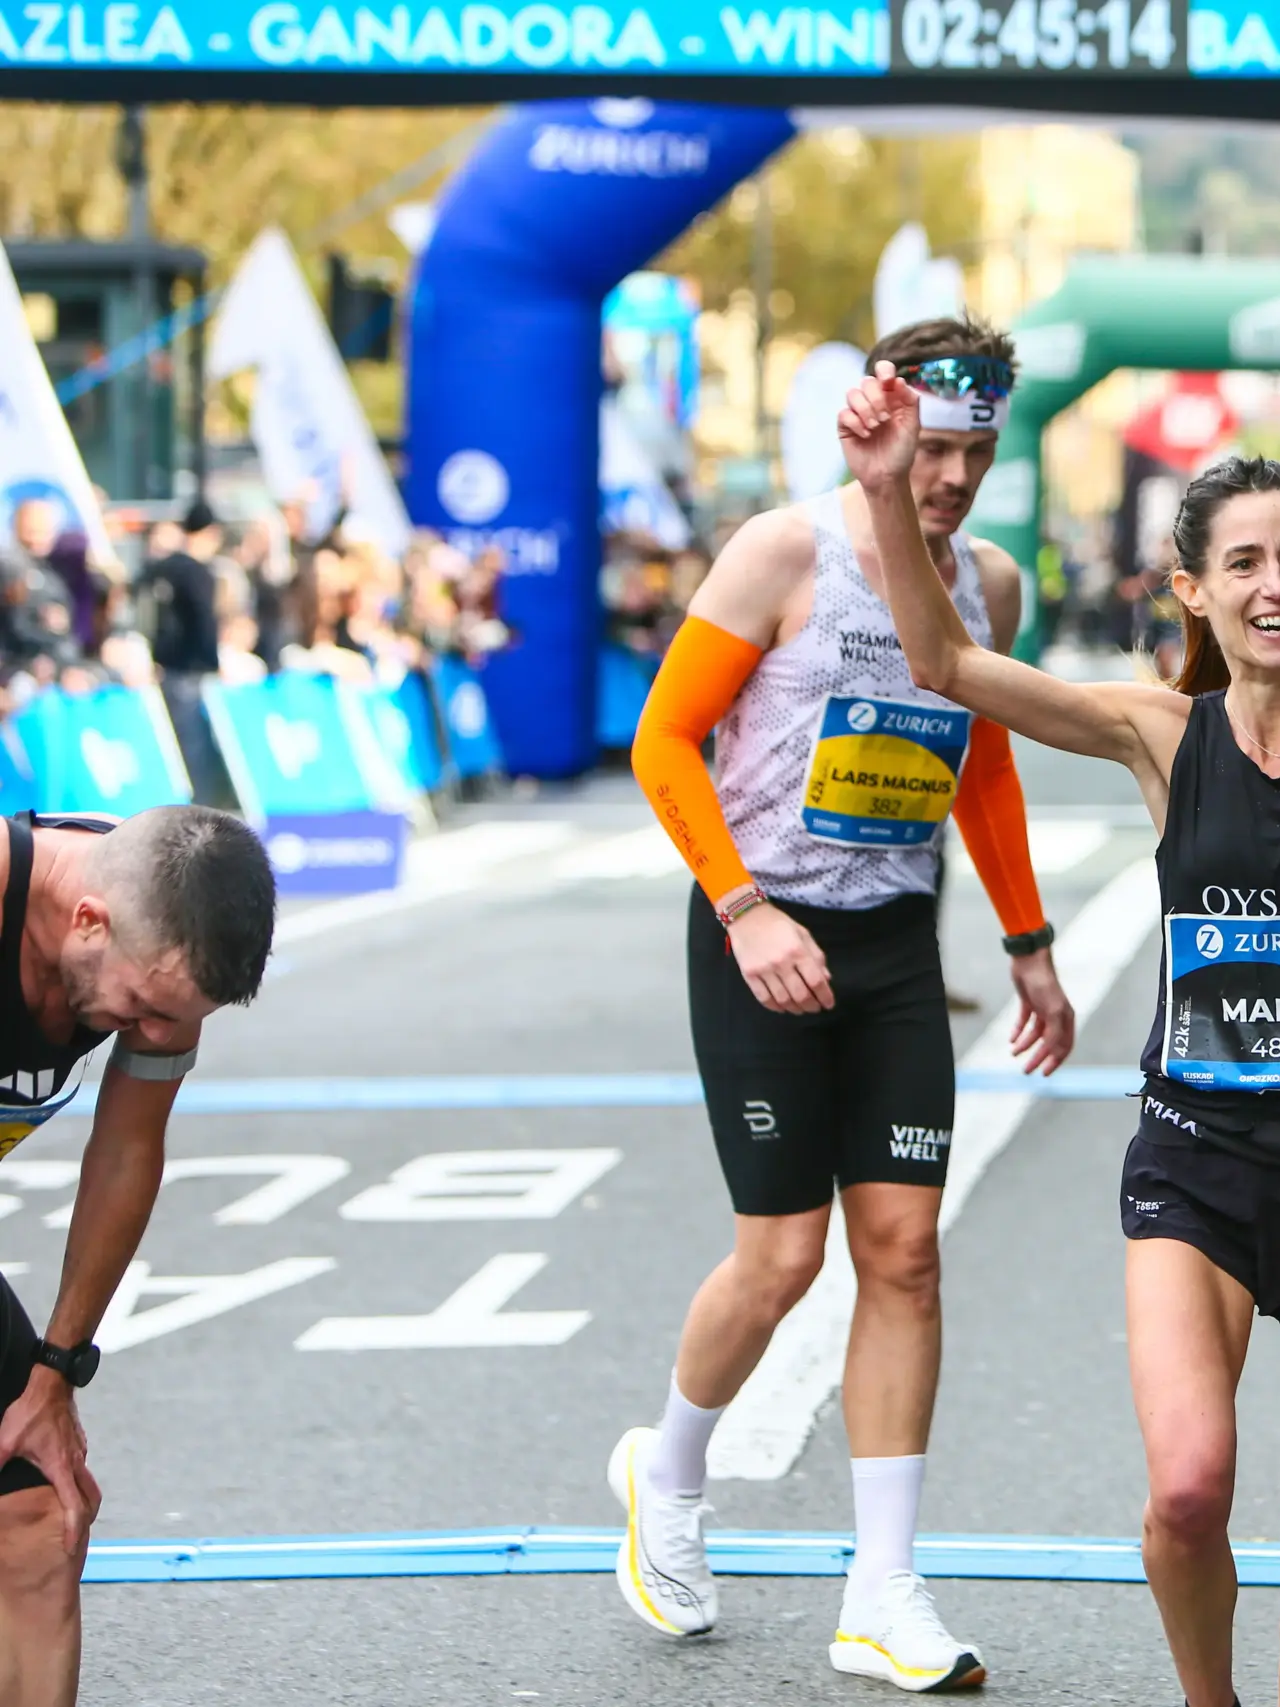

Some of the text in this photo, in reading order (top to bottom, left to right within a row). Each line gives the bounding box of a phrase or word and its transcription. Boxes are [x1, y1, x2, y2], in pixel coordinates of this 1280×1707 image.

[248, 2, 666, 68] GANADORA
[902, 0, 1175, 70] 02:45:14
[529, 123, 710, 178] ZURICH
[882, 711, 953, 736] ZURICH
[831, 767, 952, 795] LARS MAGNUS
[867, 796, 903, 817] 382
[1173, 1026, 1191, 1059] 42k
[1183, 1072, 1215, 1080] EUSKADI
[889, 1140, 938, 1161] WELL
